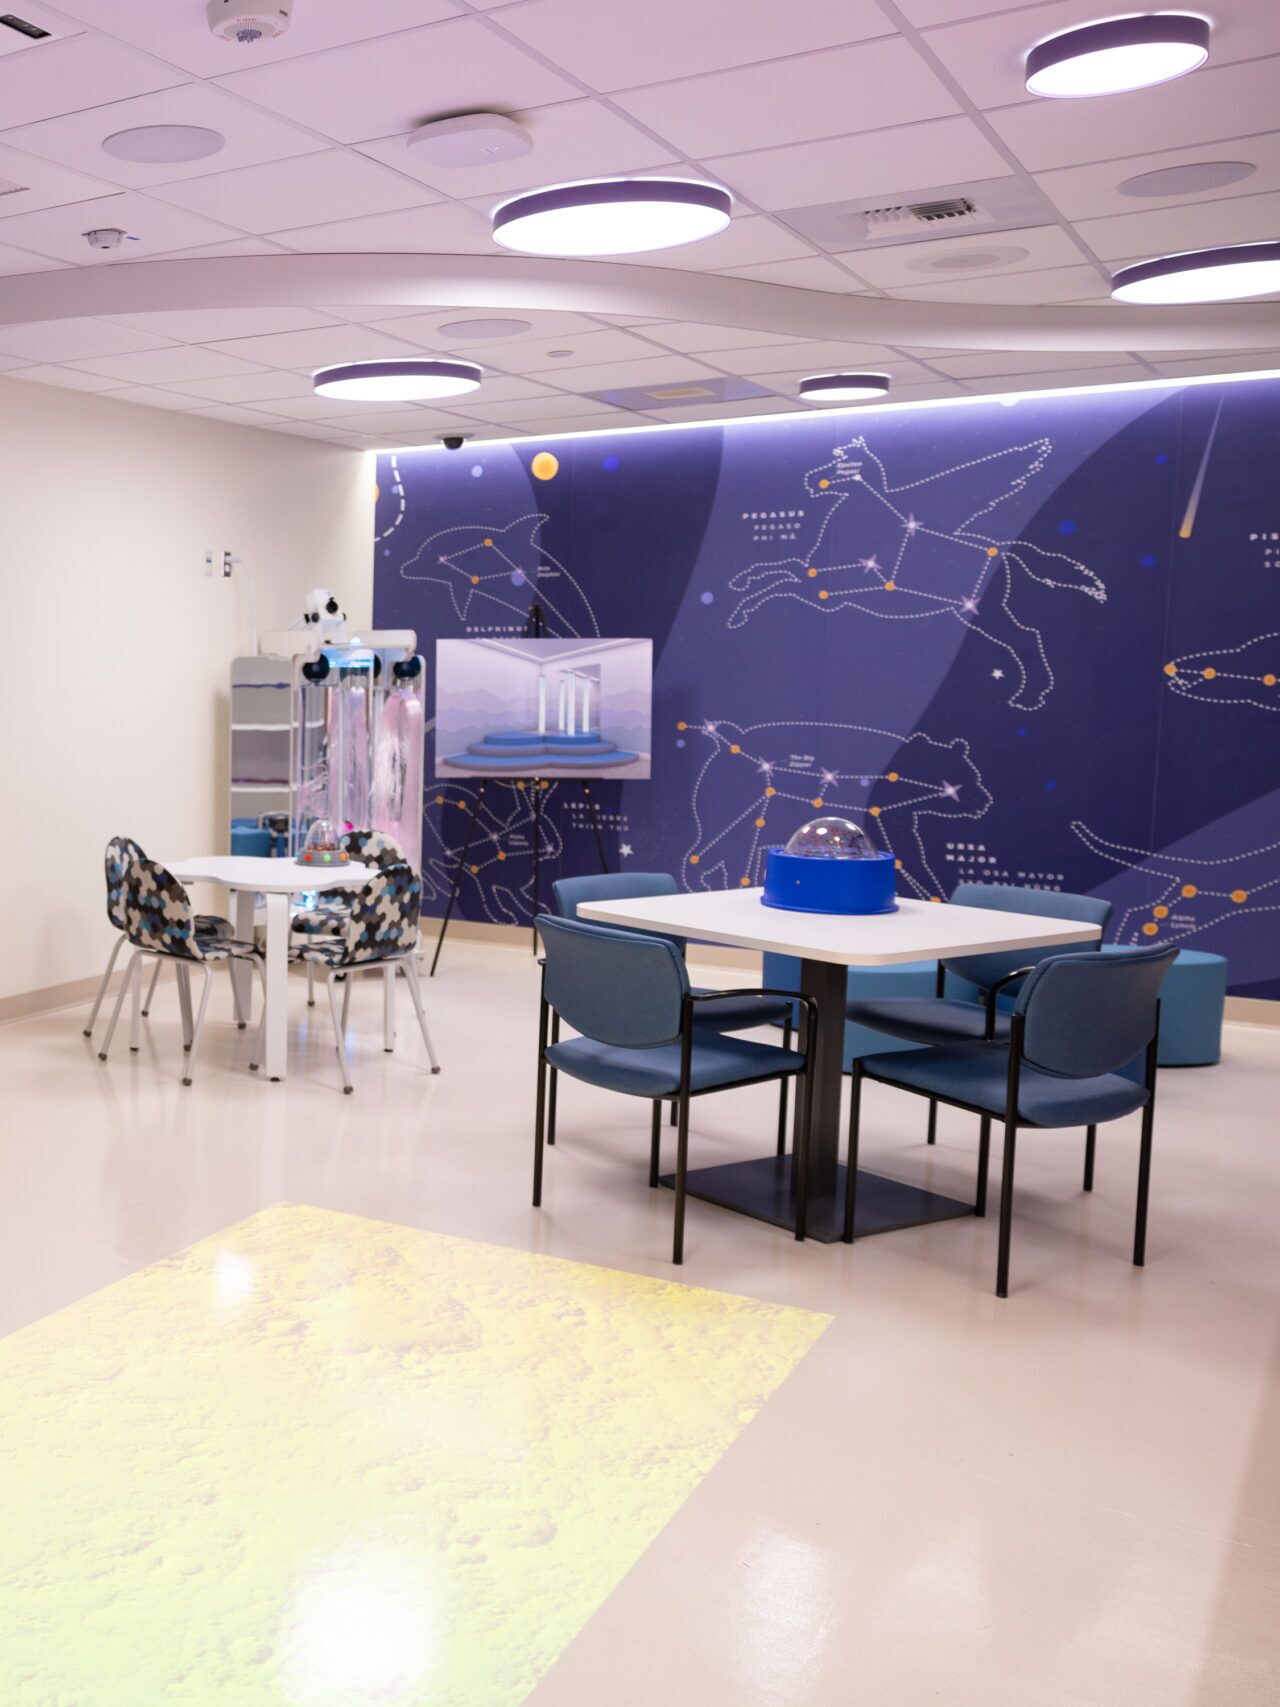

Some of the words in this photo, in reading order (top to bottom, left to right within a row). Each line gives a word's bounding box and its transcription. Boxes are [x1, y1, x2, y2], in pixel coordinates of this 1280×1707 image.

[742, 510, 804, 520] PEGASUS
[753, 522, 801, 531] PEGASO
[945, 842, 986, 852] URSA
[945, 854, 997, 864] MAJOR
[958, 868, 975, 876] LA
[982, 869, 1009, 878] OSA
[1017, 872, 1065, 881] MAYOR
